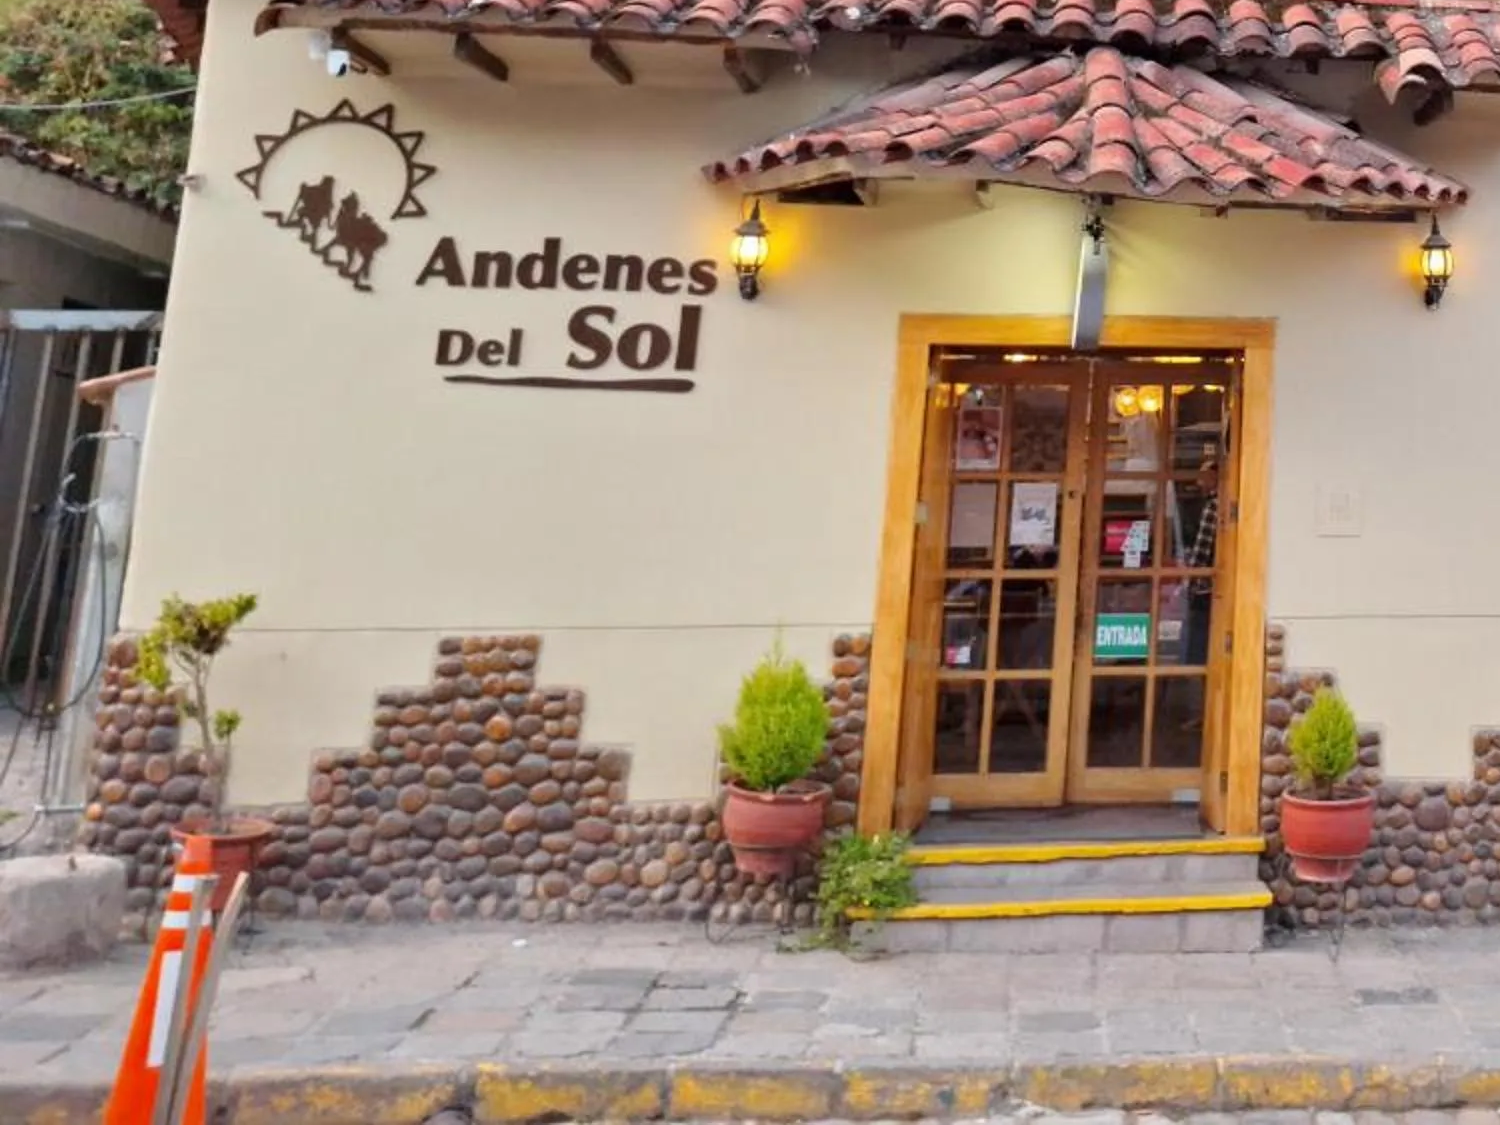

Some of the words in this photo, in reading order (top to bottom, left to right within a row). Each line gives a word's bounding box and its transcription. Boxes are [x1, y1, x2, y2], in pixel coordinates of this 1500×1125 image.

[415, 236, 718, 295] Andenes
[435, 328, 523, 366] Del
[566, 304, 703, 371] Sol
[1097, 625, 1148, 647] ENTRADA
